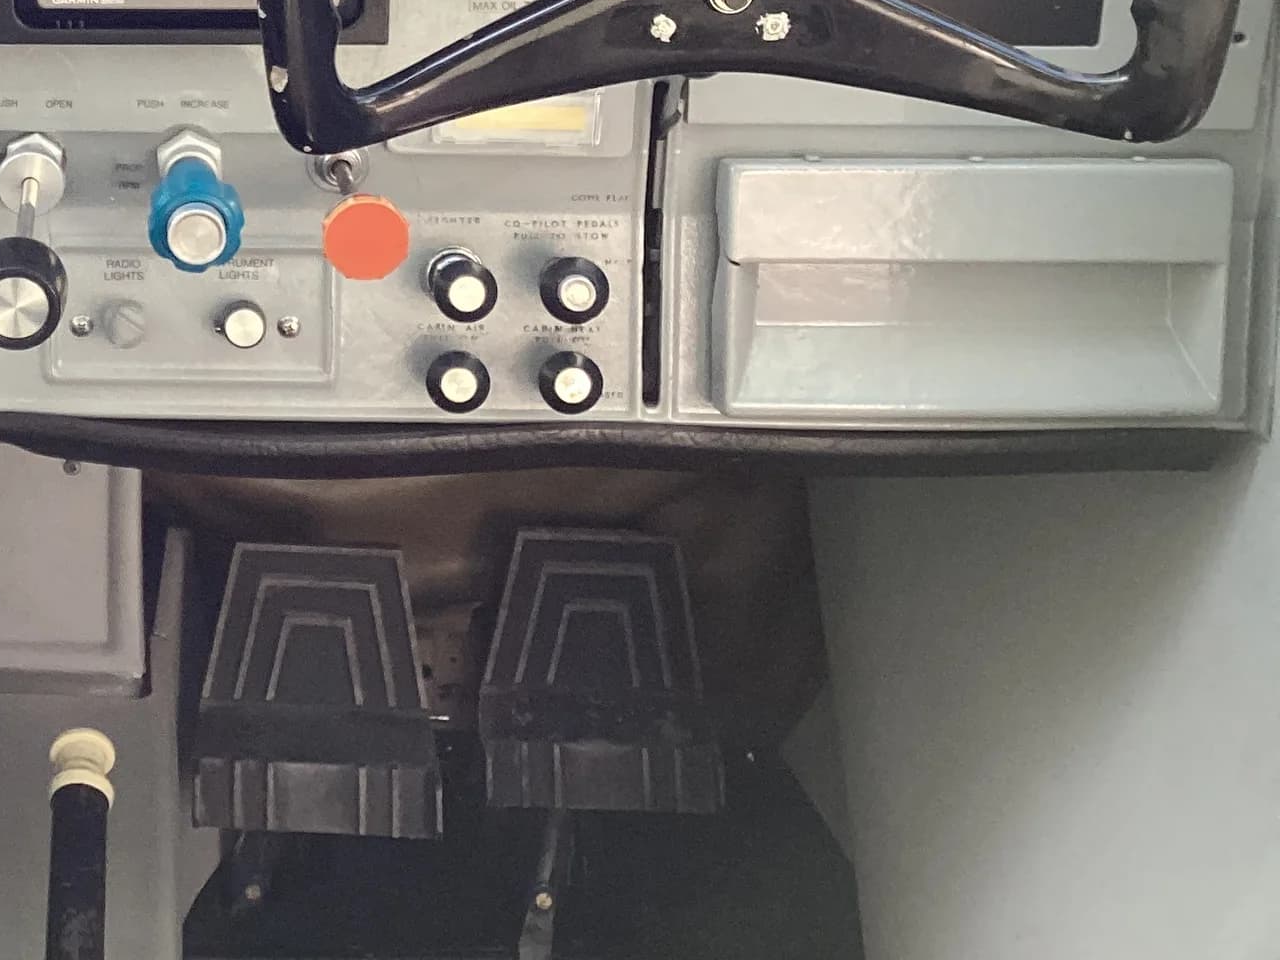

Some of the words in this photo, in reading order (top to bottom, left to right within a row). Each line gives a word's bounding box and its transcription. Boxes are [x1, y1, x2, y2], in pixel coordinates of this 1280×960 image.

[472, 2, 498, 10] MAX
[46, 100, 72, 109] OPEN
[504, 220, 567, 228] CO-PILOT
[106, 259, 141, 269] RADIO
[104, 271, 144, 281] LIGHTS
[218, 271, 259, 280] LIGHTS
